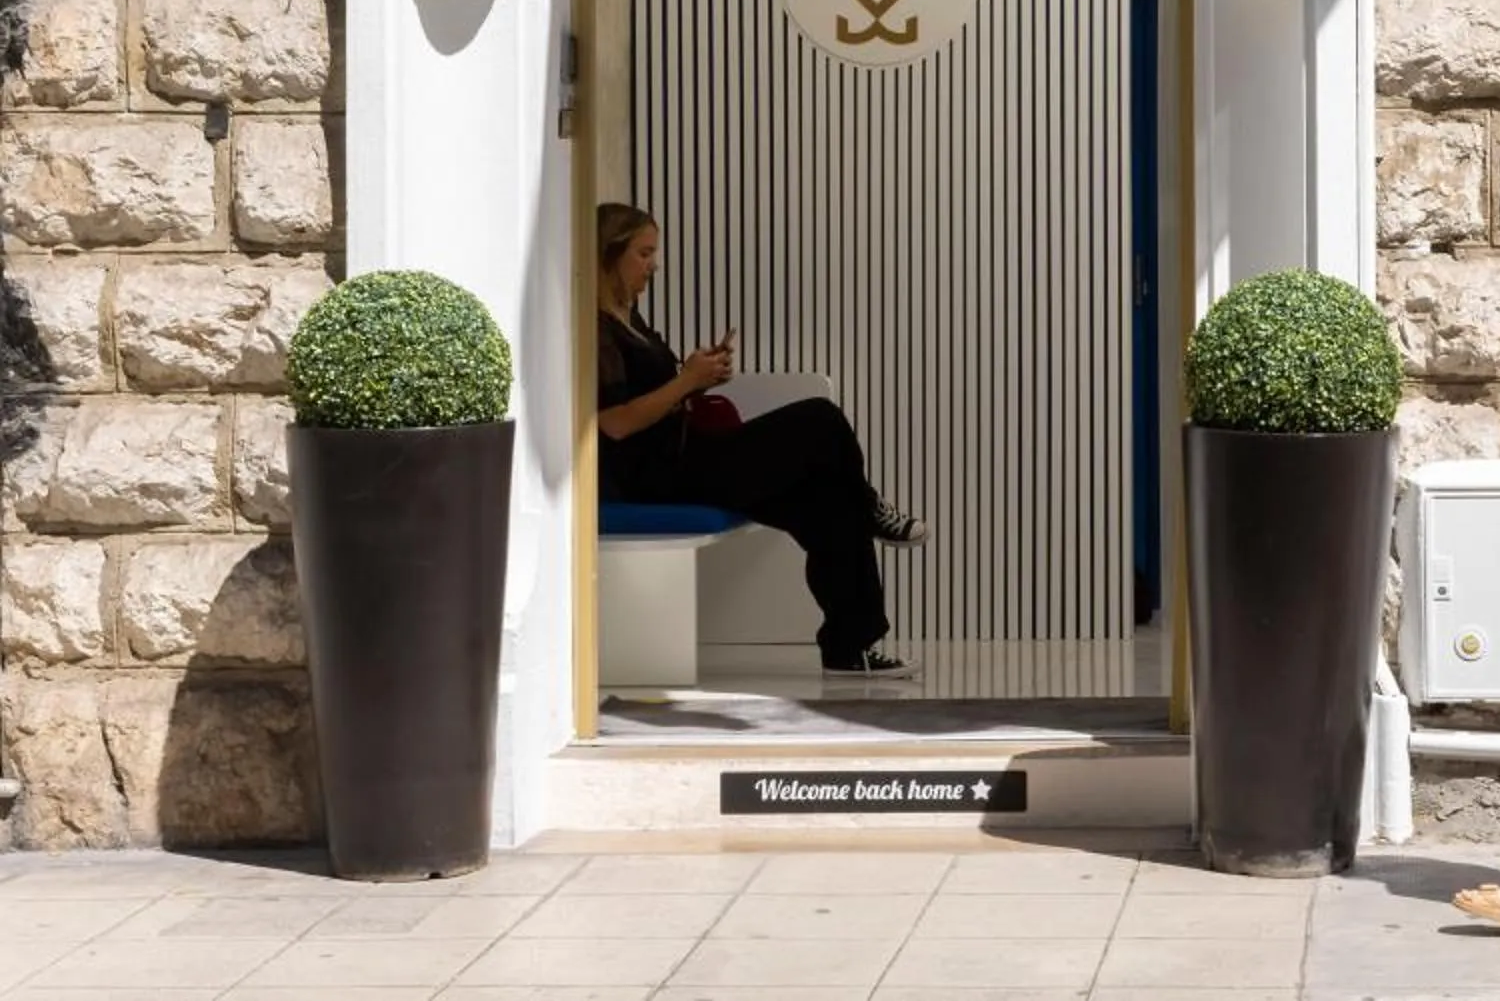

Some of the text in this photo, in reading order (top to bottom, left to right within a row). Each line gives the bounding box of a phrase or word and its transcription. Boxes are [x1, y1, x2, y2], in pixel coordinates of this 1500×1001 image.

[755, 778, 965, 801] Welcome back home
